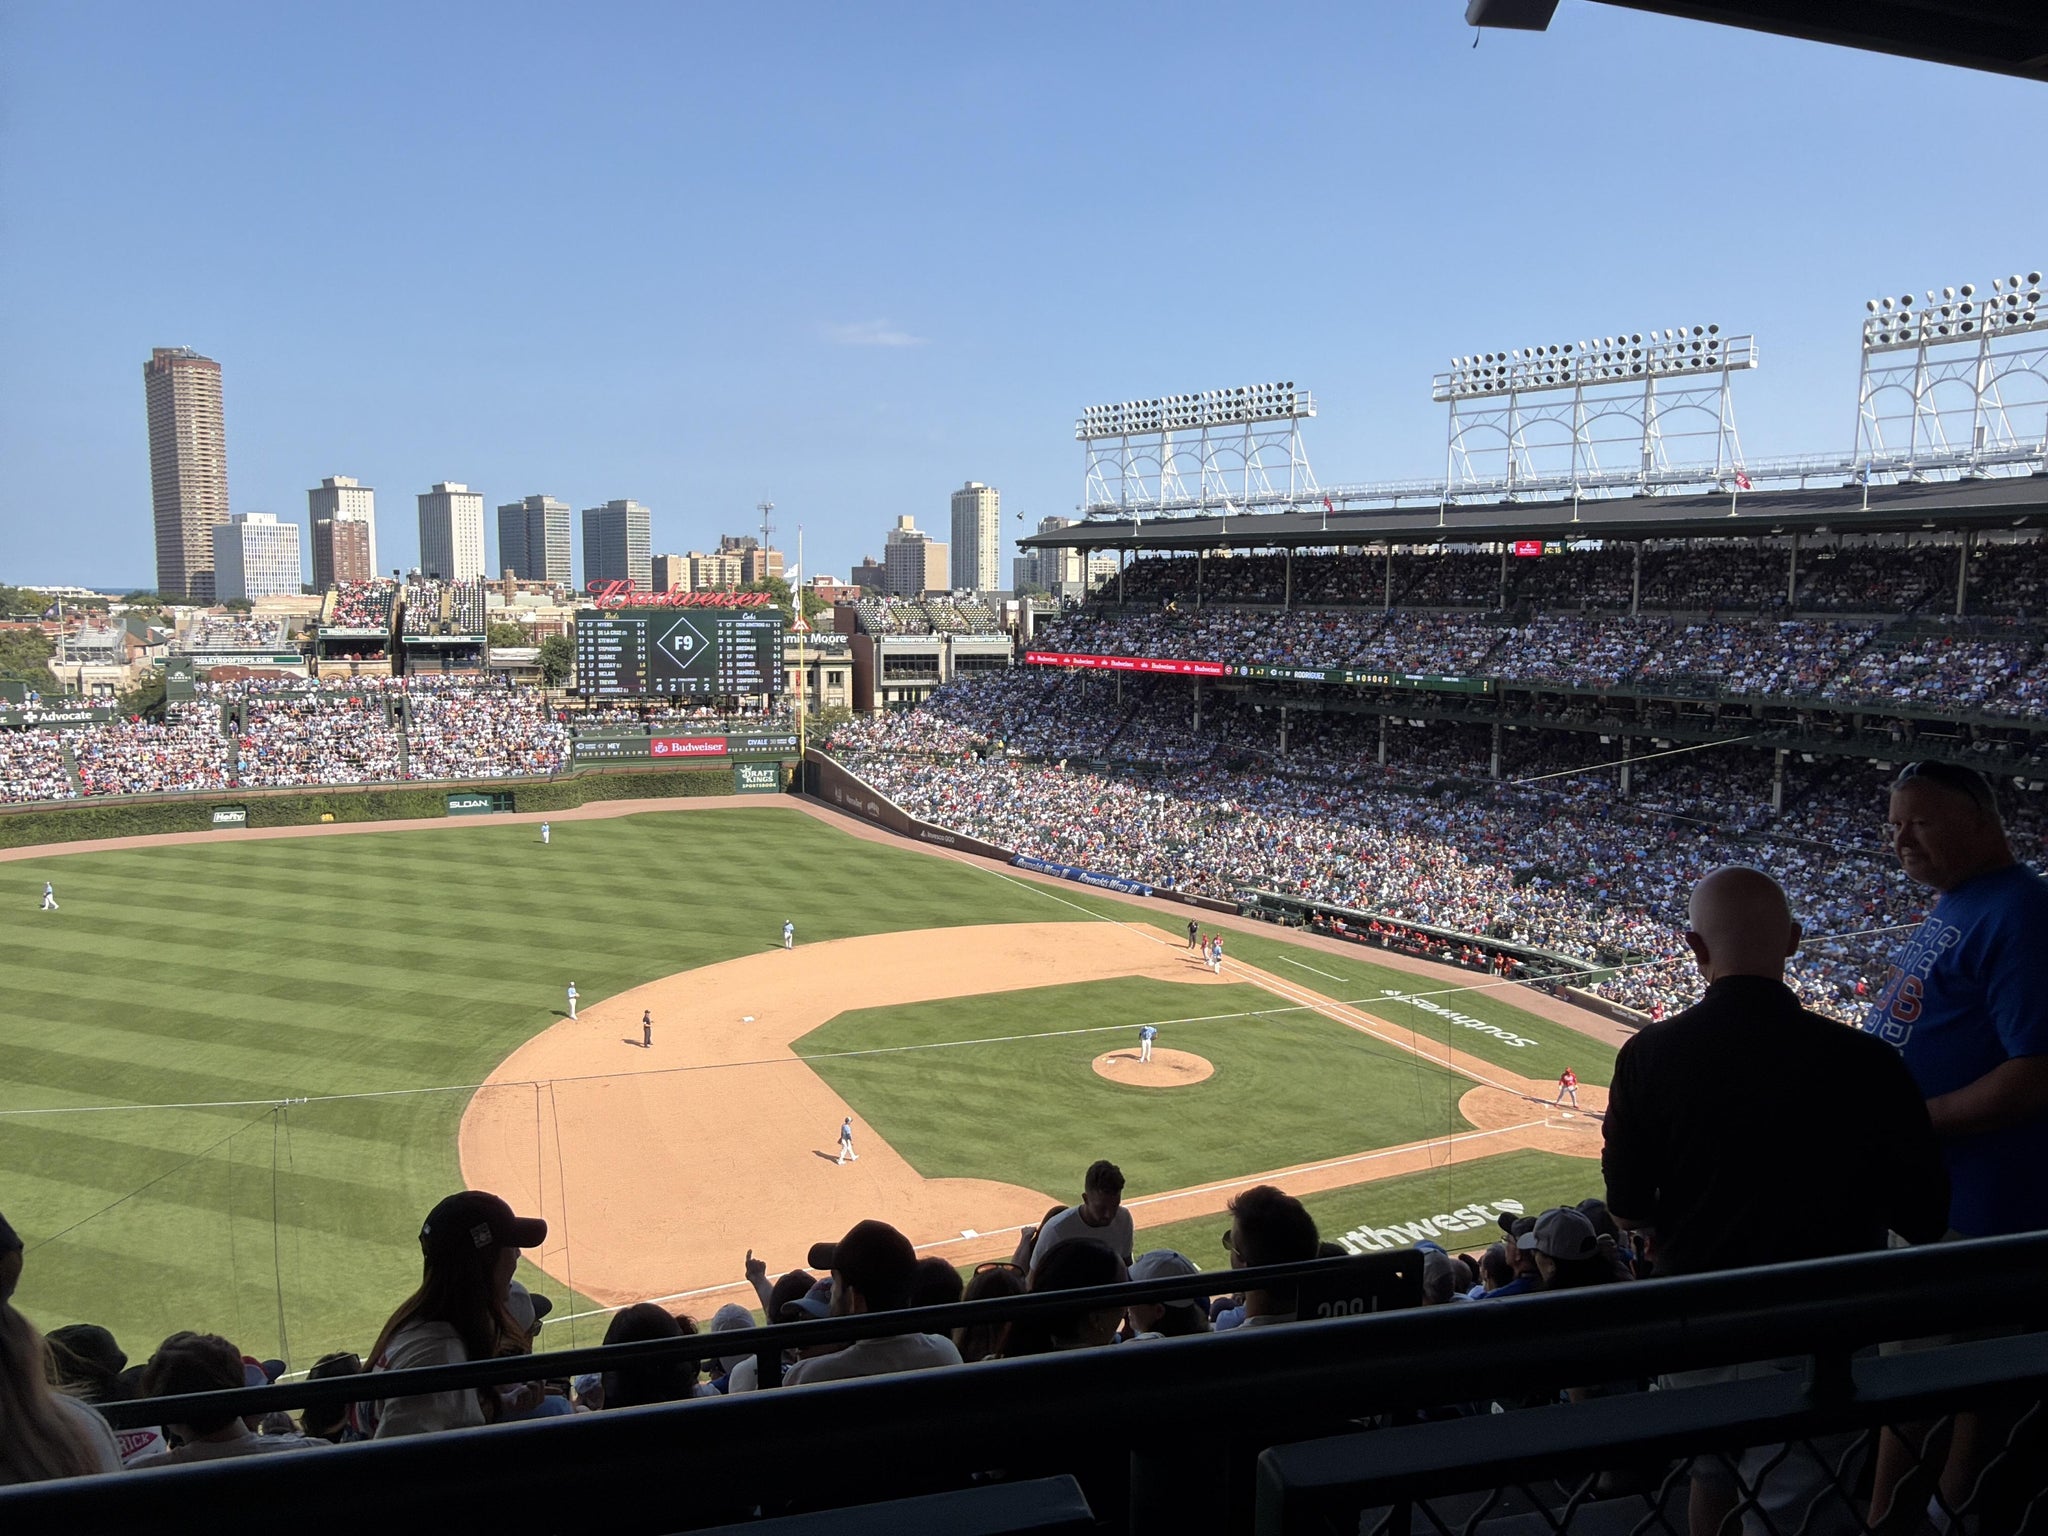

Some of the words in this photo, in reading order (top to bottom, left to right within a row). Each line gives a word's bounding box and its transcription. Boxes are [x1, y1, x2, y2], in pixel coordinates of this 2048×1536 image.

[587, 578, 772, 609] Budweiser
[675, 636, 693, 650] F9
[810, 634, 846, 644] Moore
[40, 711, 92, 721] Advocate
[672, 743, 724, 752] Budweiser
[742, 768, 774, 777] DRAFT
[449, 800, 488, 808] SLOAN
[216, 813, 243, 821] Hefty
[1016, 856, 1043, 874] Reynolds
[1043, 864, 1061, 877] Wrap
[1078, 872, 1110, 888] Reynolds
[1109, 879, 1128, 892] Wrap
[1394, 996, 1538, 1048] Southwest
